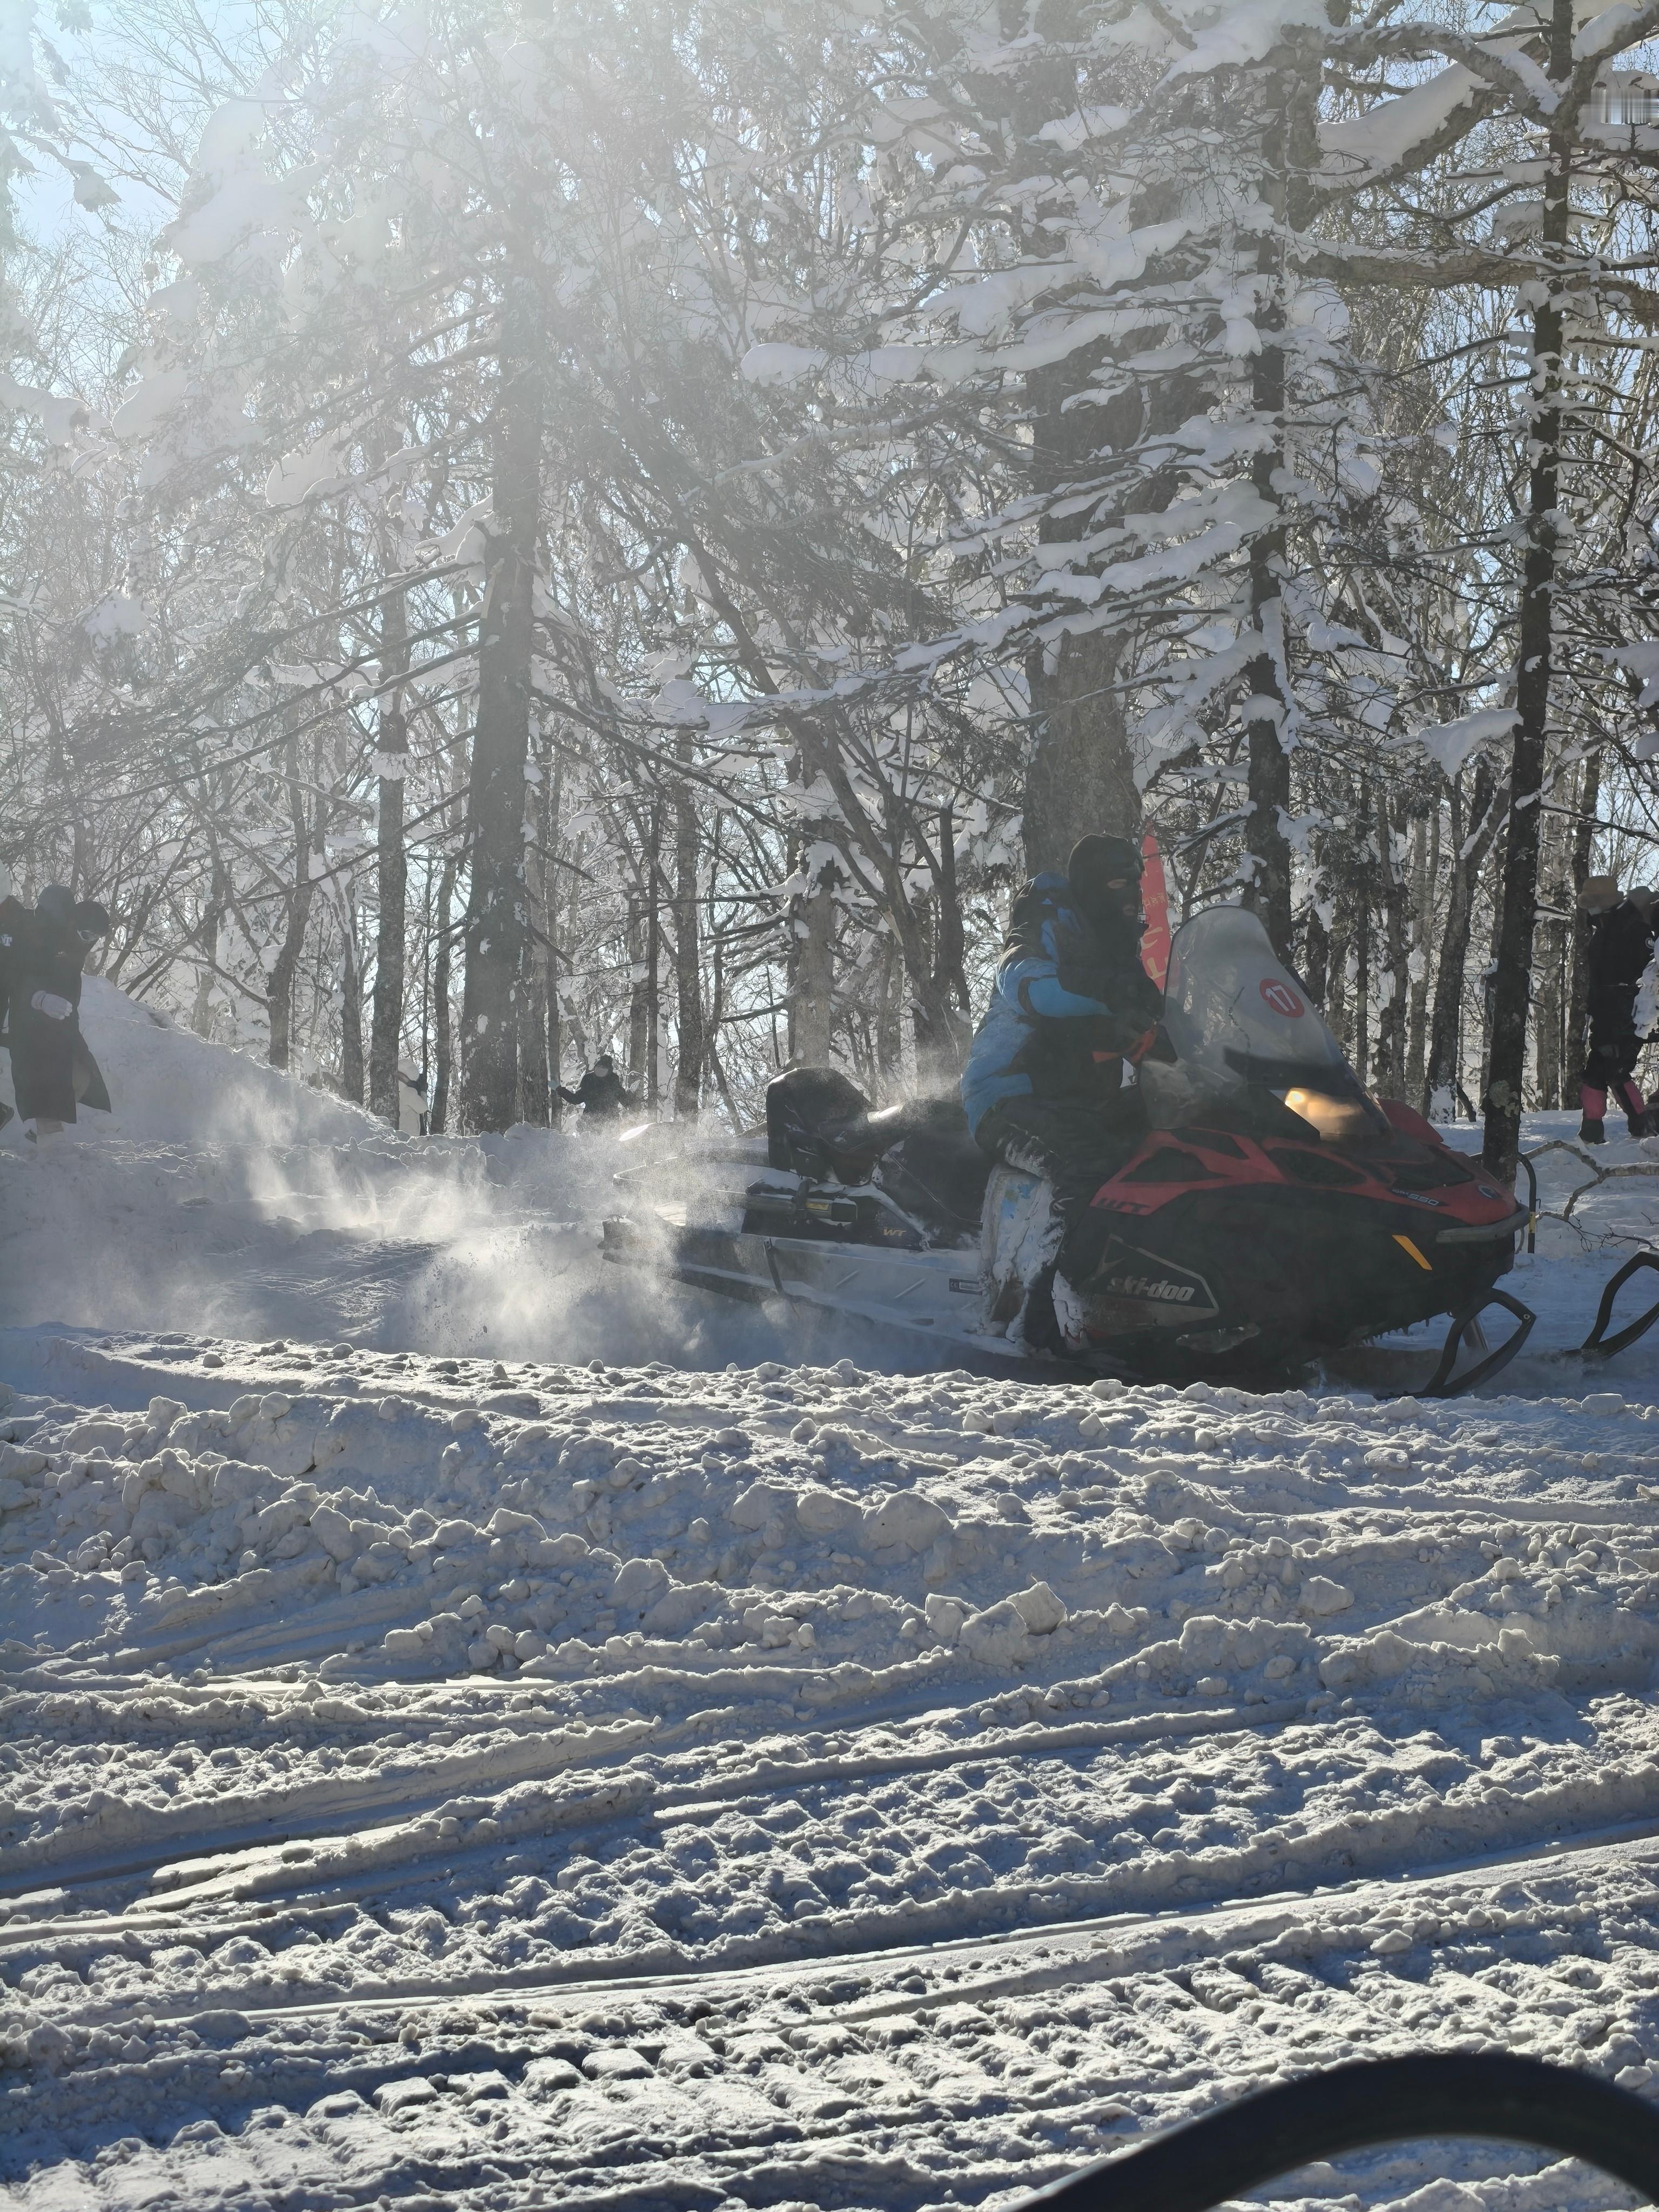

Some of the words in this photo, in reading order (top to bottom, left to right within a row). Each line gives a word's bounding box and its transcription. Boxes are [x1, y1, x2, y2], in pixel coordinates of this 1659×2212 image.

[1265, 984, 1297, 1011] 17
[1407, 1193, 1440, 1206] 550
[883, 1226, 907, 1237] WT
[1107, 1275, 1195, 1301] ski-doo
